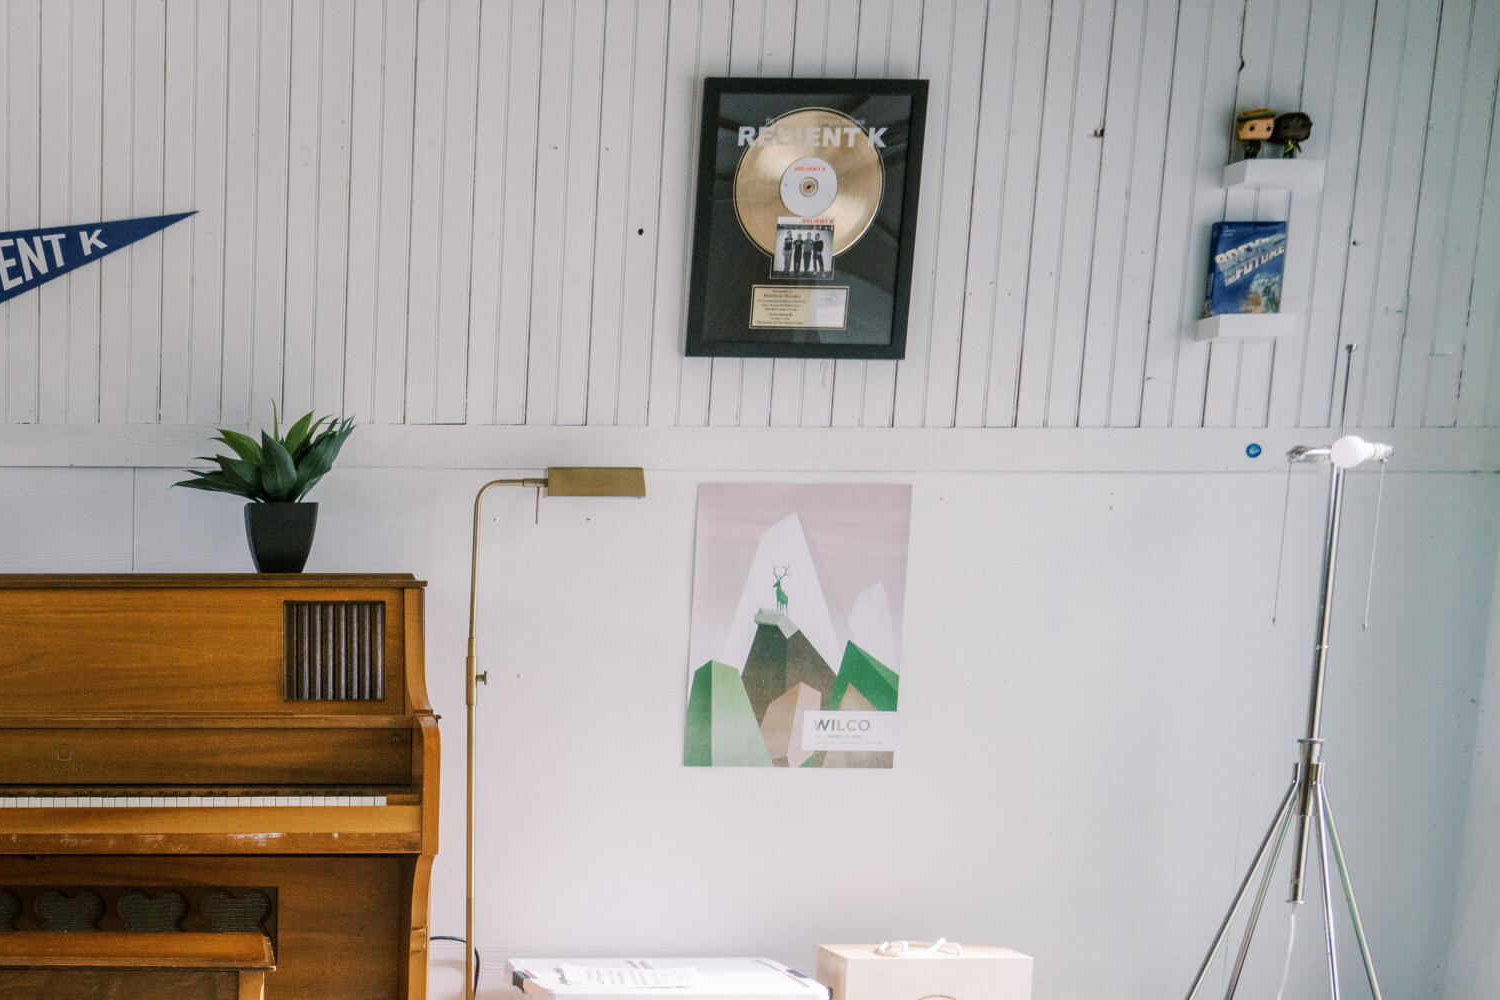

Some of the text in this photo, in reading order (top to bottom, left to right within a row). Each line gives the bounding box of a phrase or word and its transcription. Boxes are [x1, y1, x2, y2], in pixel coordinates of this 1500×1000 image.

[737, 126, 889, 148] RELIENT K
[79, 228, 109, 256] K
[813, 719, 871, 732] WILCO
